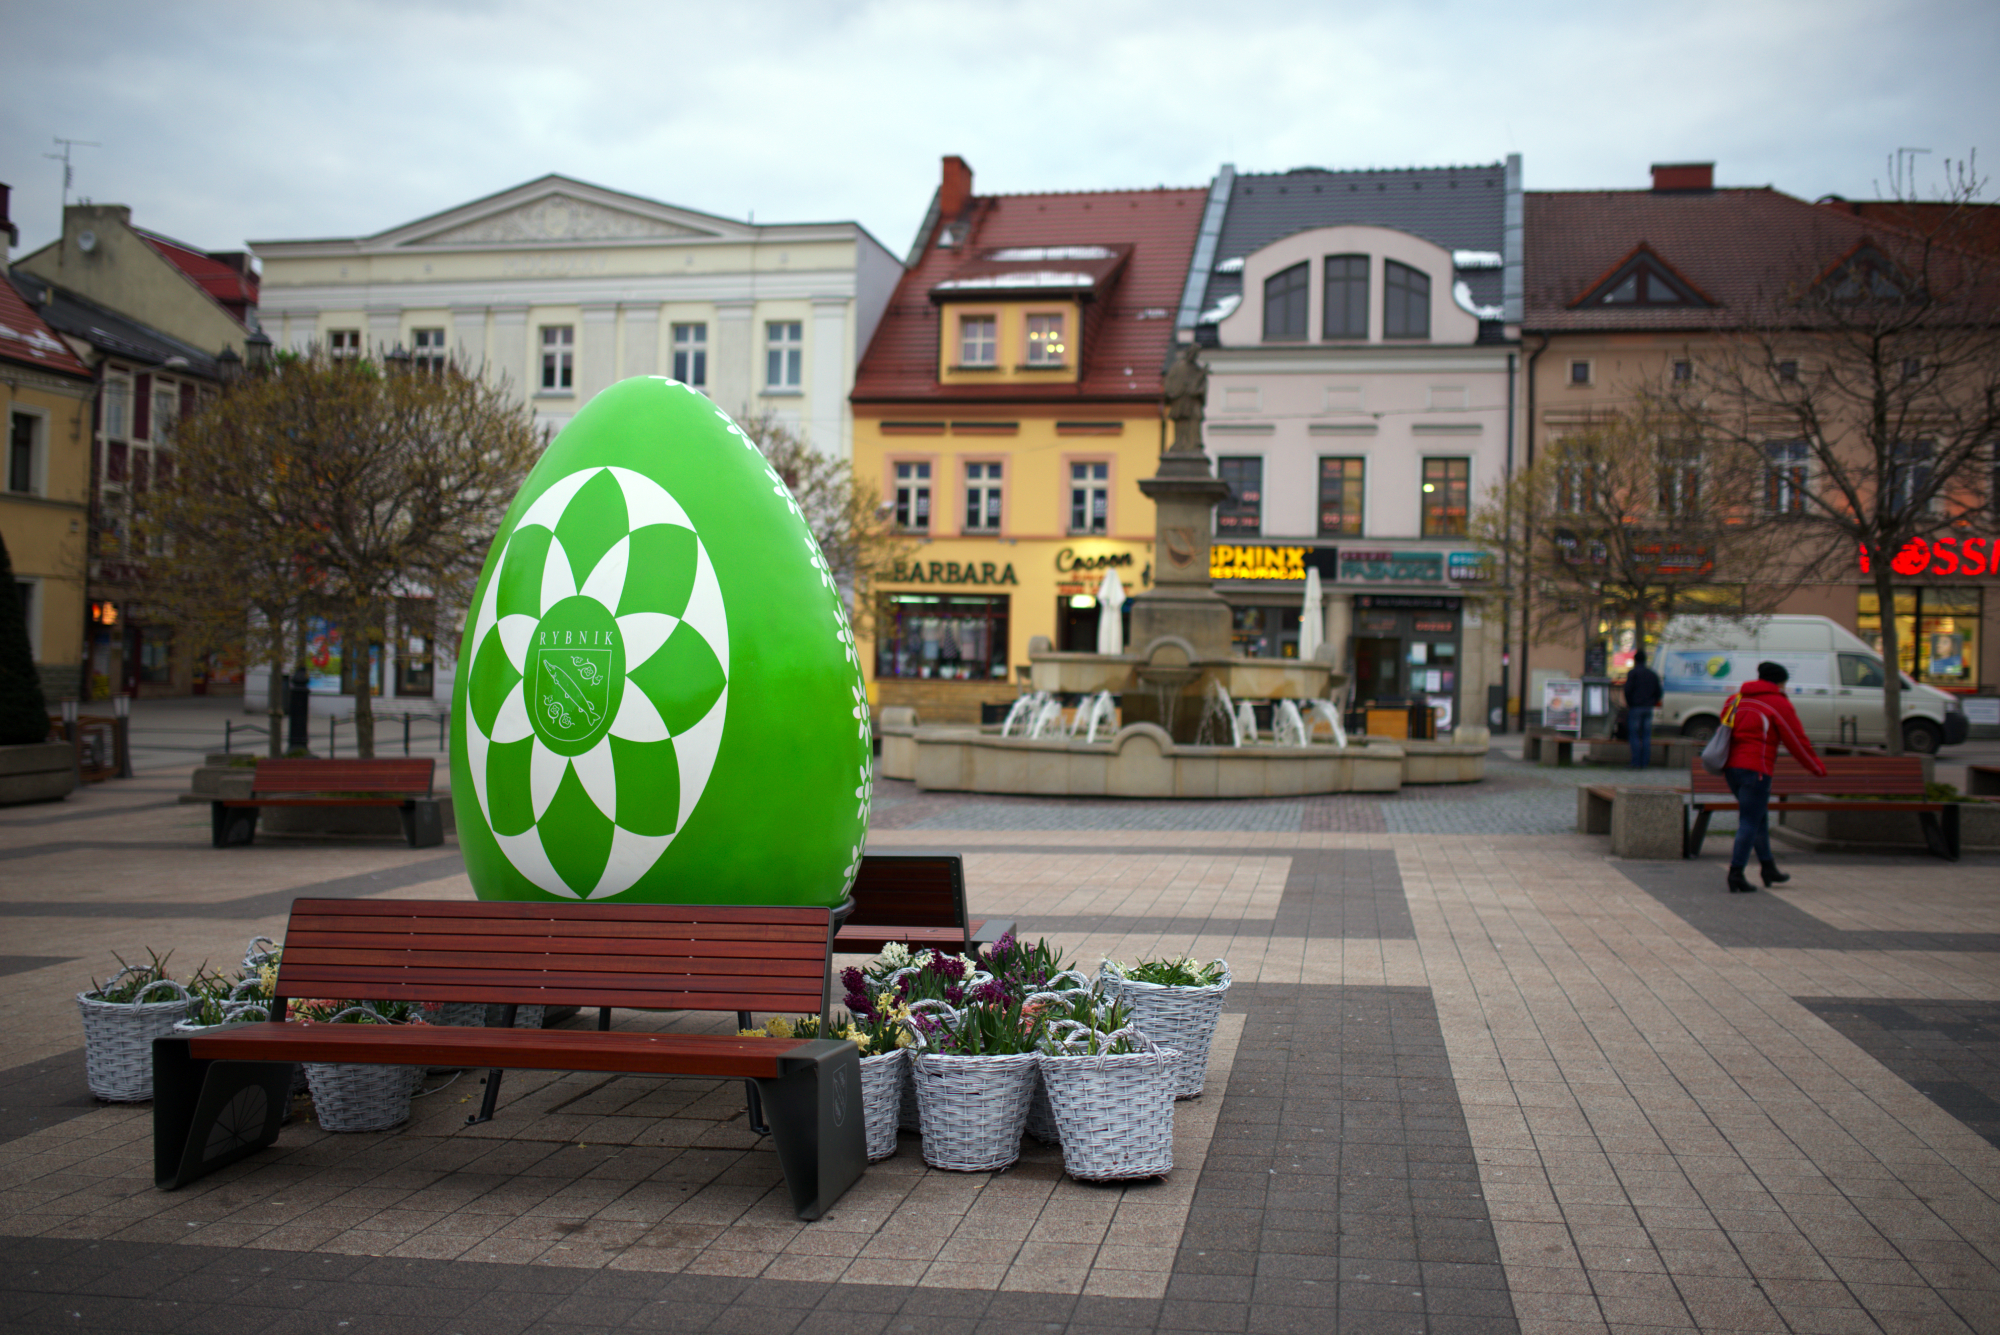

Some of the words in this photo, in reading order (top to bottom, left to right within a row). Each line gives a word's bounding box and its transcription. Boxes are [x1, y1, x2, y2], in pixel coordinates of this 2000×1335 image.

[1860, 536, 2000, 575] OSS
[893, 561, 1018, 585] BARBARA
[539, 631, 613, 645] RYBNIK
